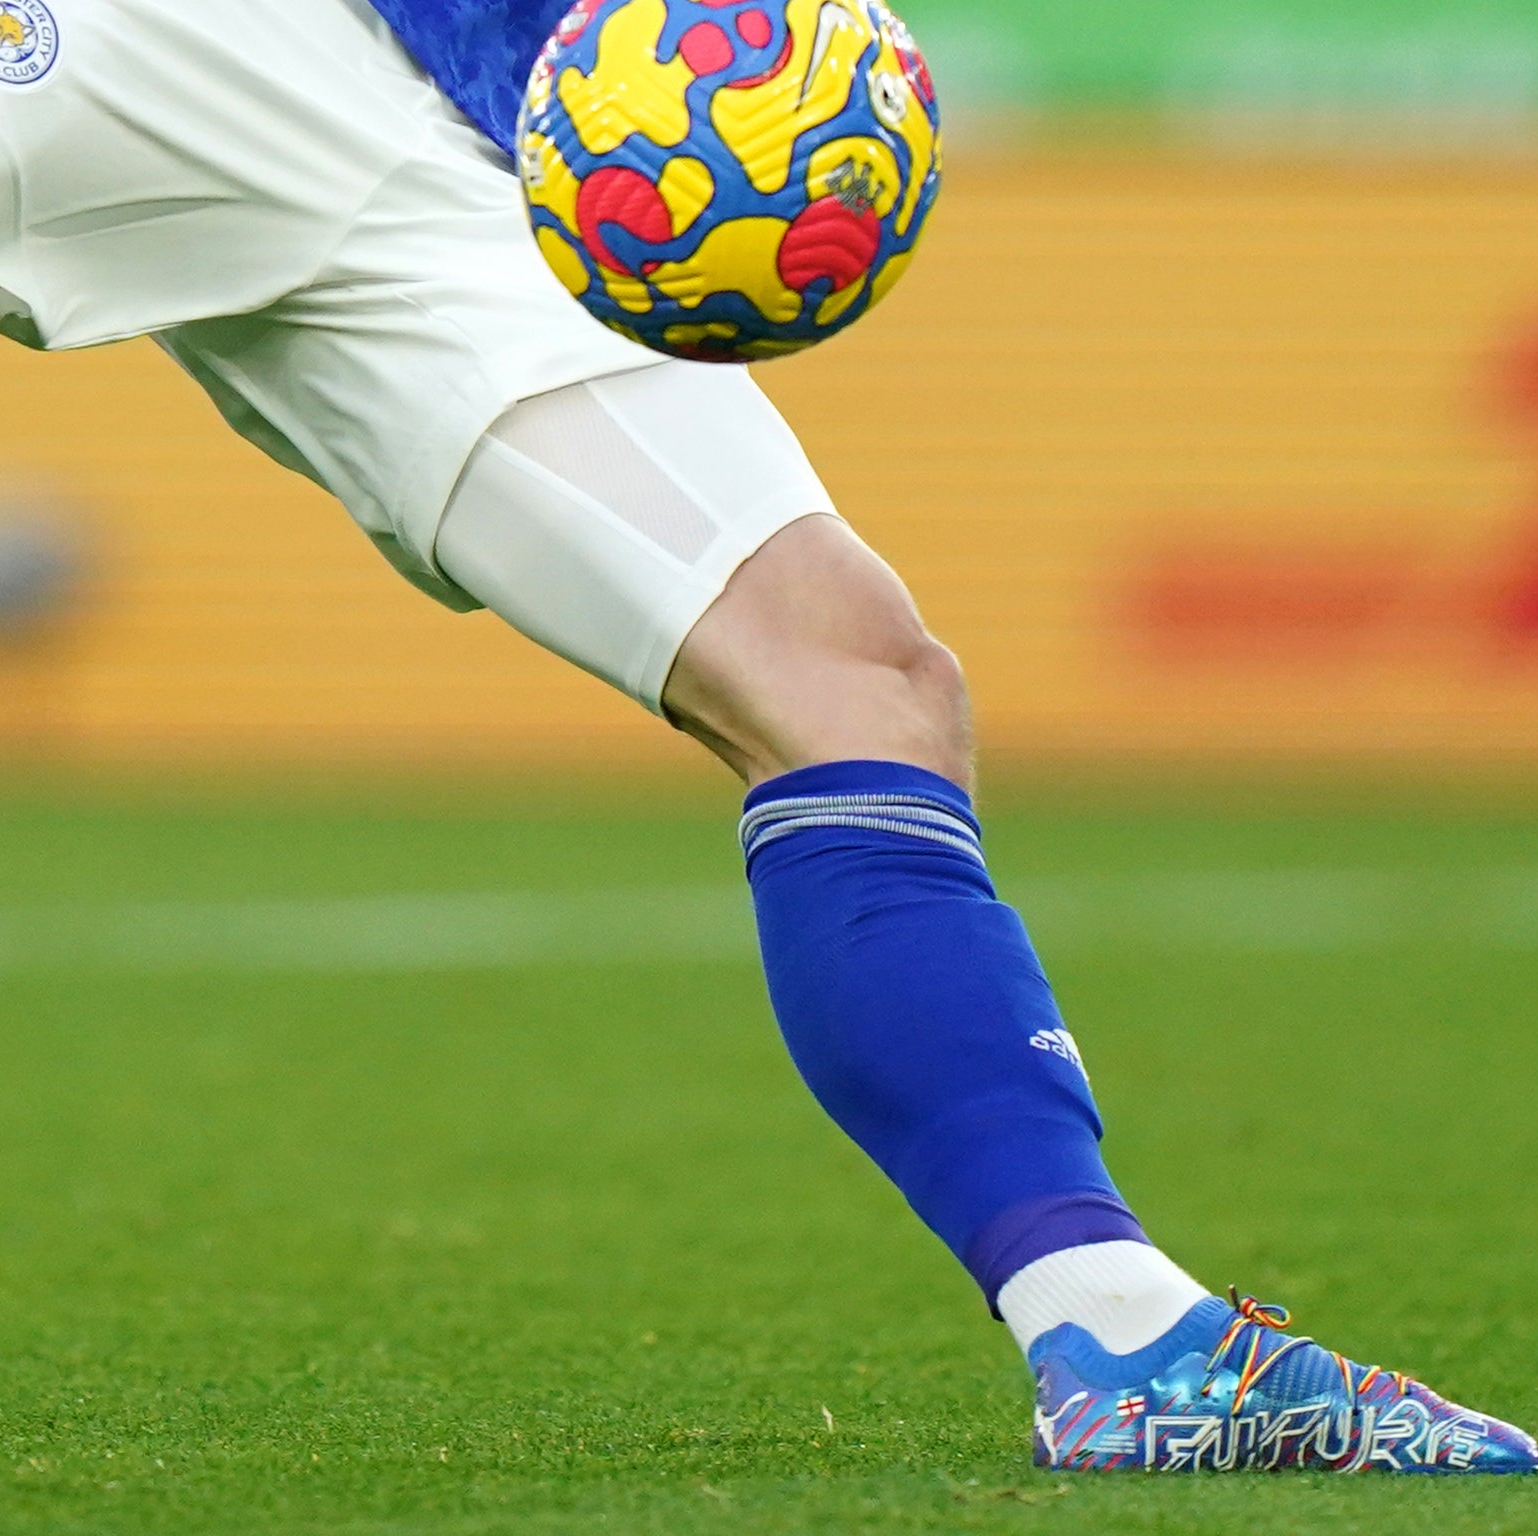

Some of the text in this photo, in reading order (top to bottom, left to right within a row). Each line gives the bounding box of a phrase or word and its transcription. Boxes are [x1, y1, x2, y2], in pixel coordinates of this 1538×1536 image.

[39, 25, 53, 61] CITY
[2, 61, 40, 78] CLUB
[1145, 1399, 1489, 1474] FUTURE
